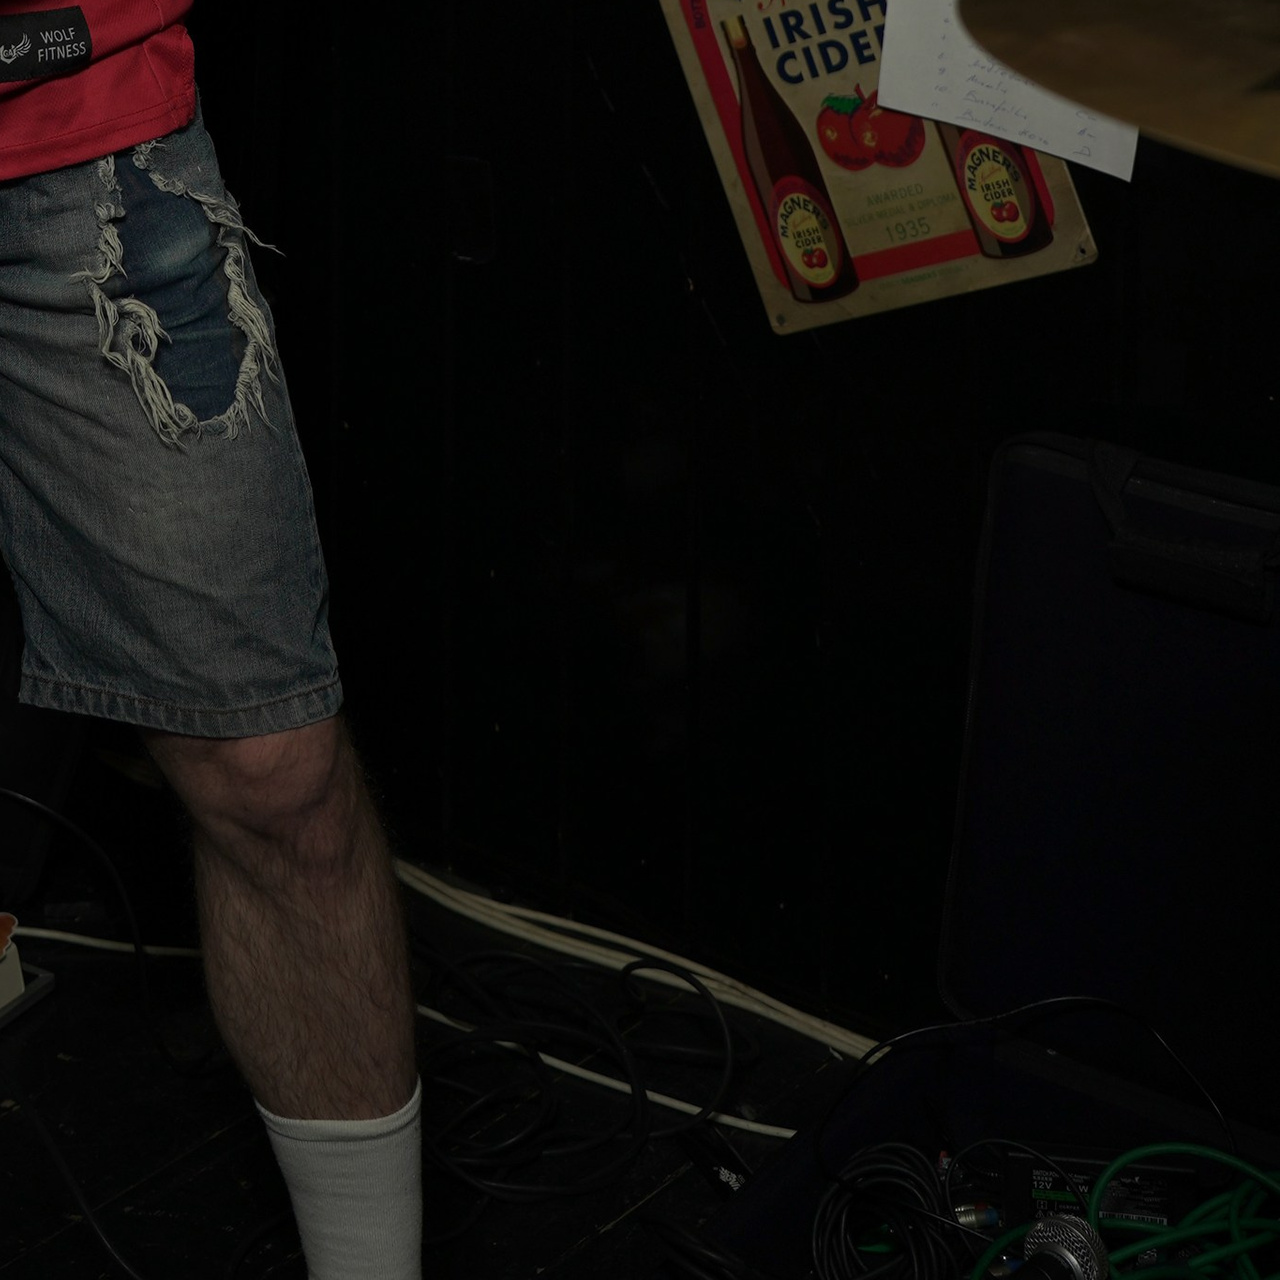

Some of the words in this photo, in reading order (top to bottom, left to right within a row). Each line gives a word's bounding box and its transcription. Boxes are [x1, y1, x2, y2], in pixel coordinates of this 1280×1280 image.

[40, 27, 76, 44] WOLF
[38, 41, 87, 62] FITNESS
[980, 178, 1010, 193] IRISH
[866, 183, 924, 207] AWARDED
[984, 188, 1014, 202] CIDER
[792, 226, 820, 240] IRISH
[885, 216, 931, 243] 1935
[795, 236, 823, 249] CIDER
